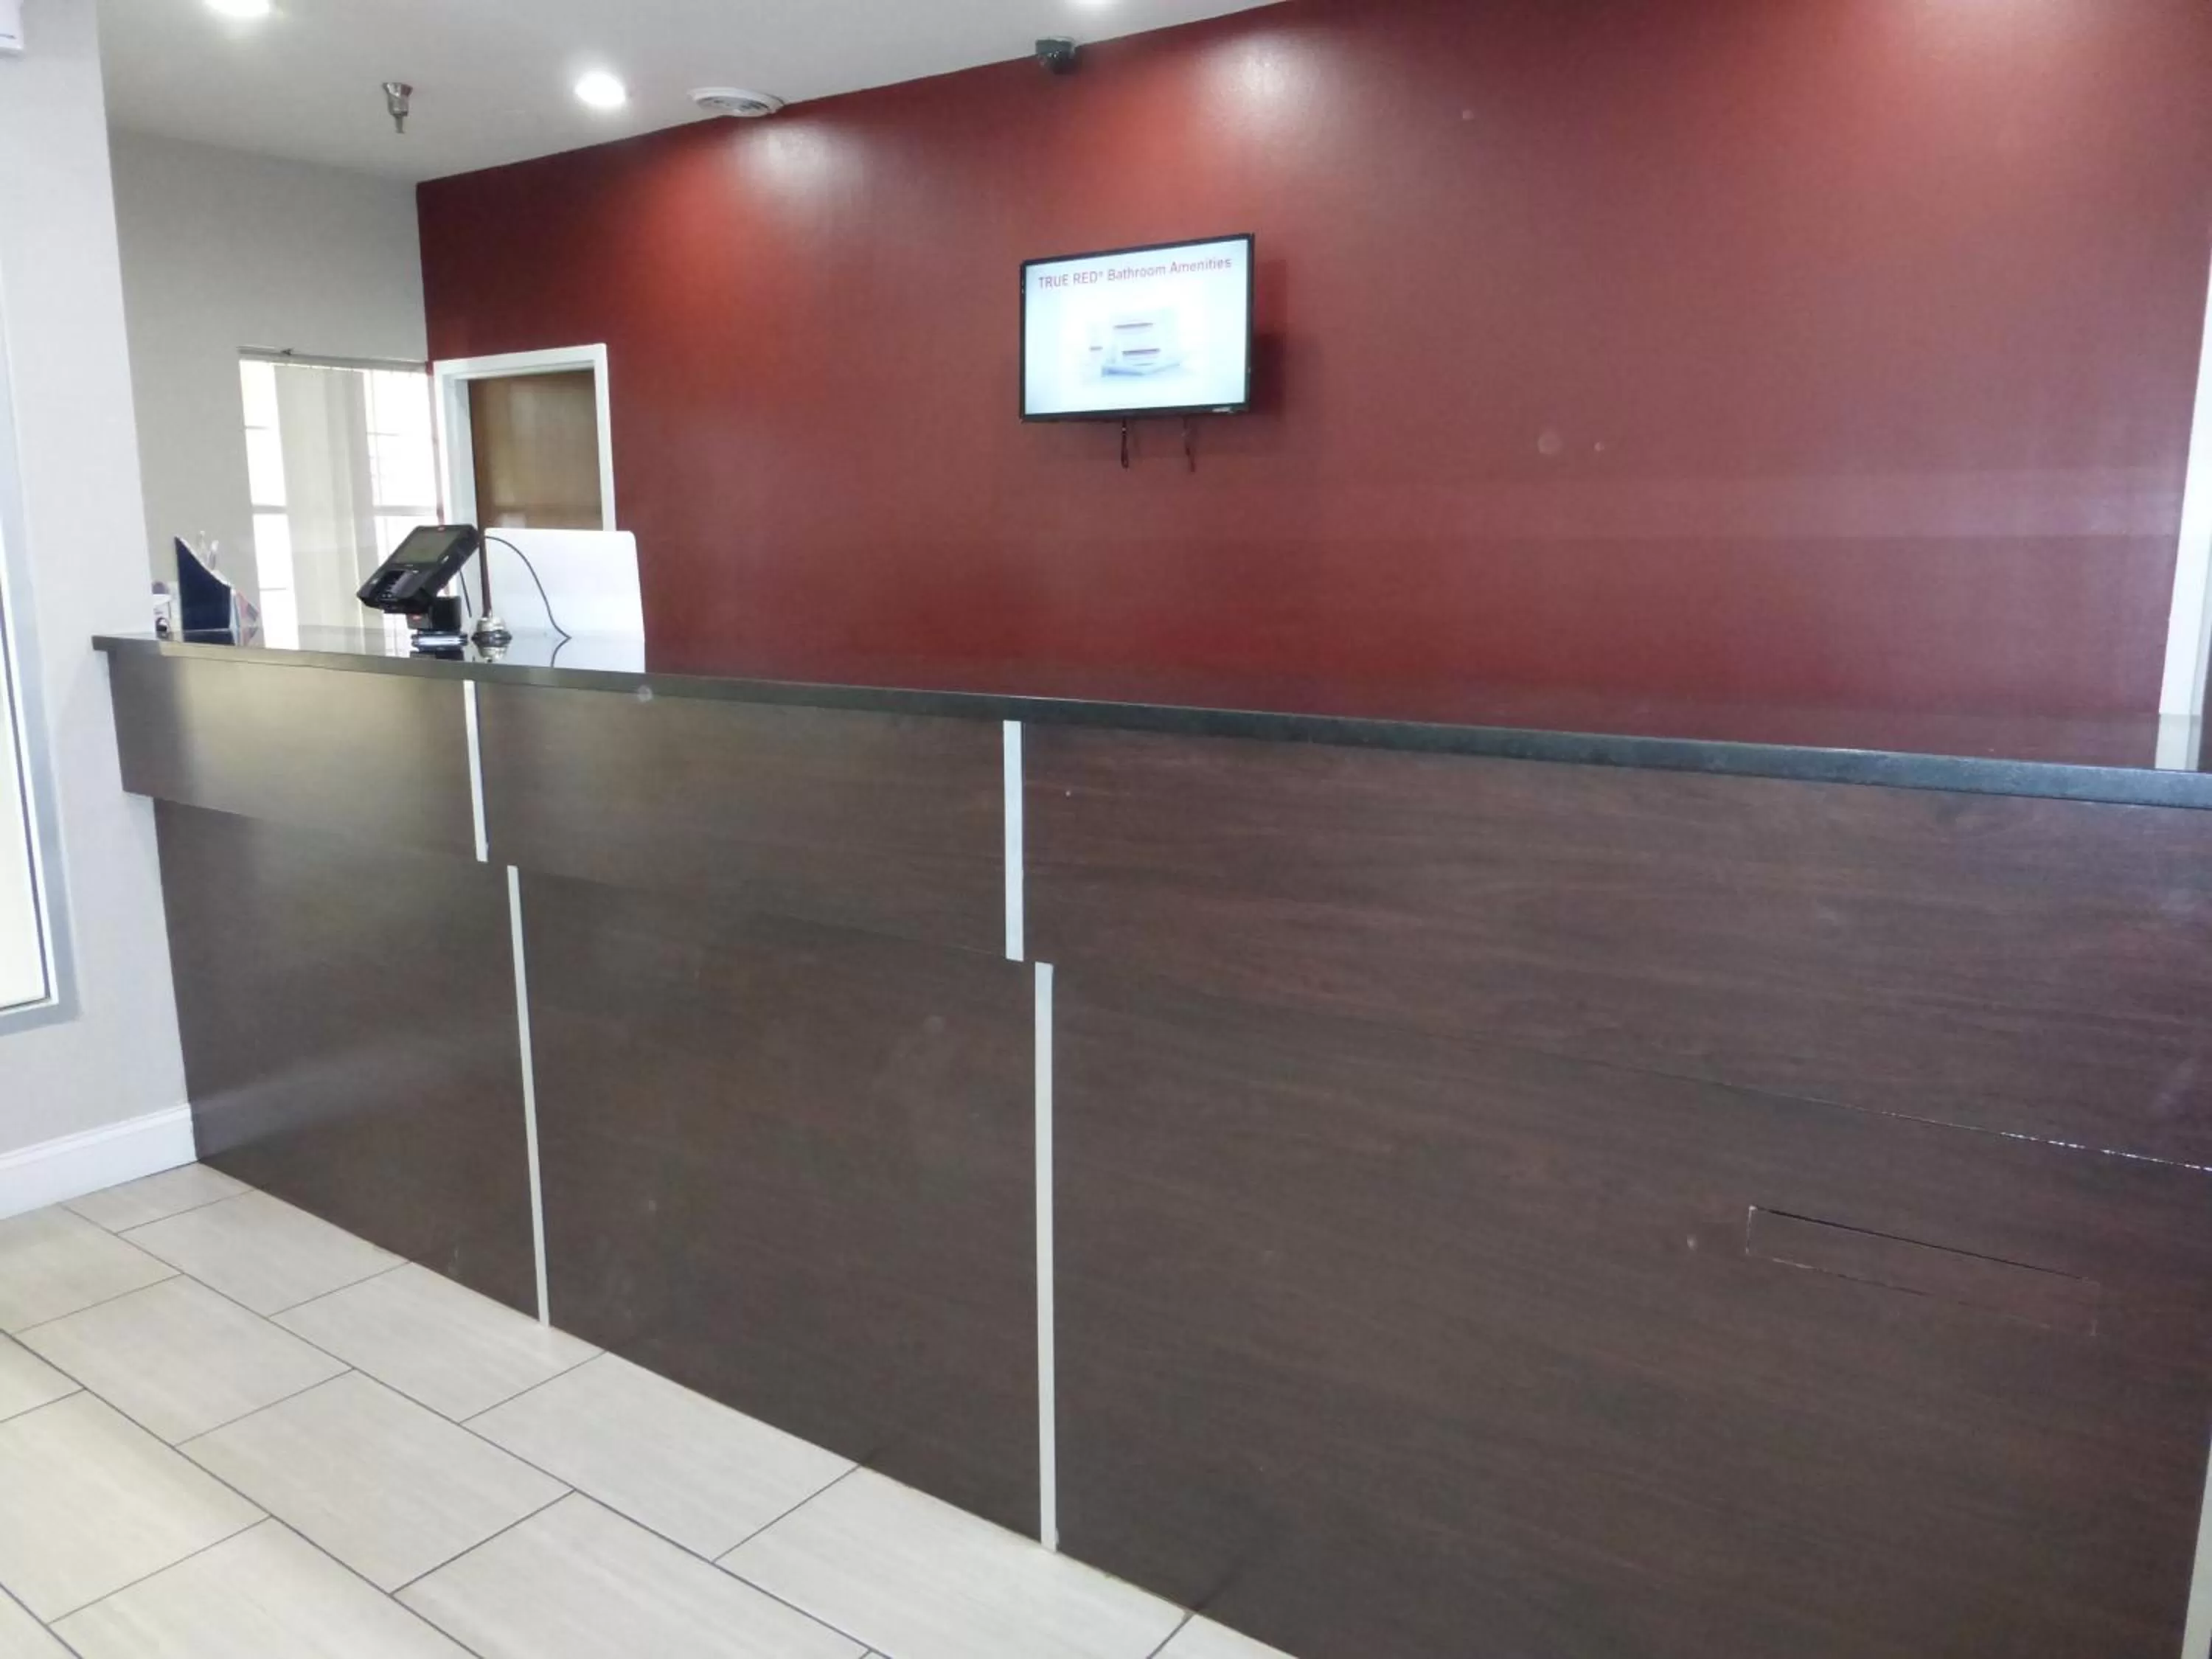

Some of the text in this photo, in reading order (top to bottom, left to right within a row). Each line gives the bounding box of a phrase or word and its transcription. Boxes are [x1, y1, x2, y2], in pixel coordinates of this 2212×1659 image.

[1038, 274, 1068, 289] TRUE
[1108, 265, 1166, 282] Bathroom
[1170, 257, 1232, 272] Amenities
